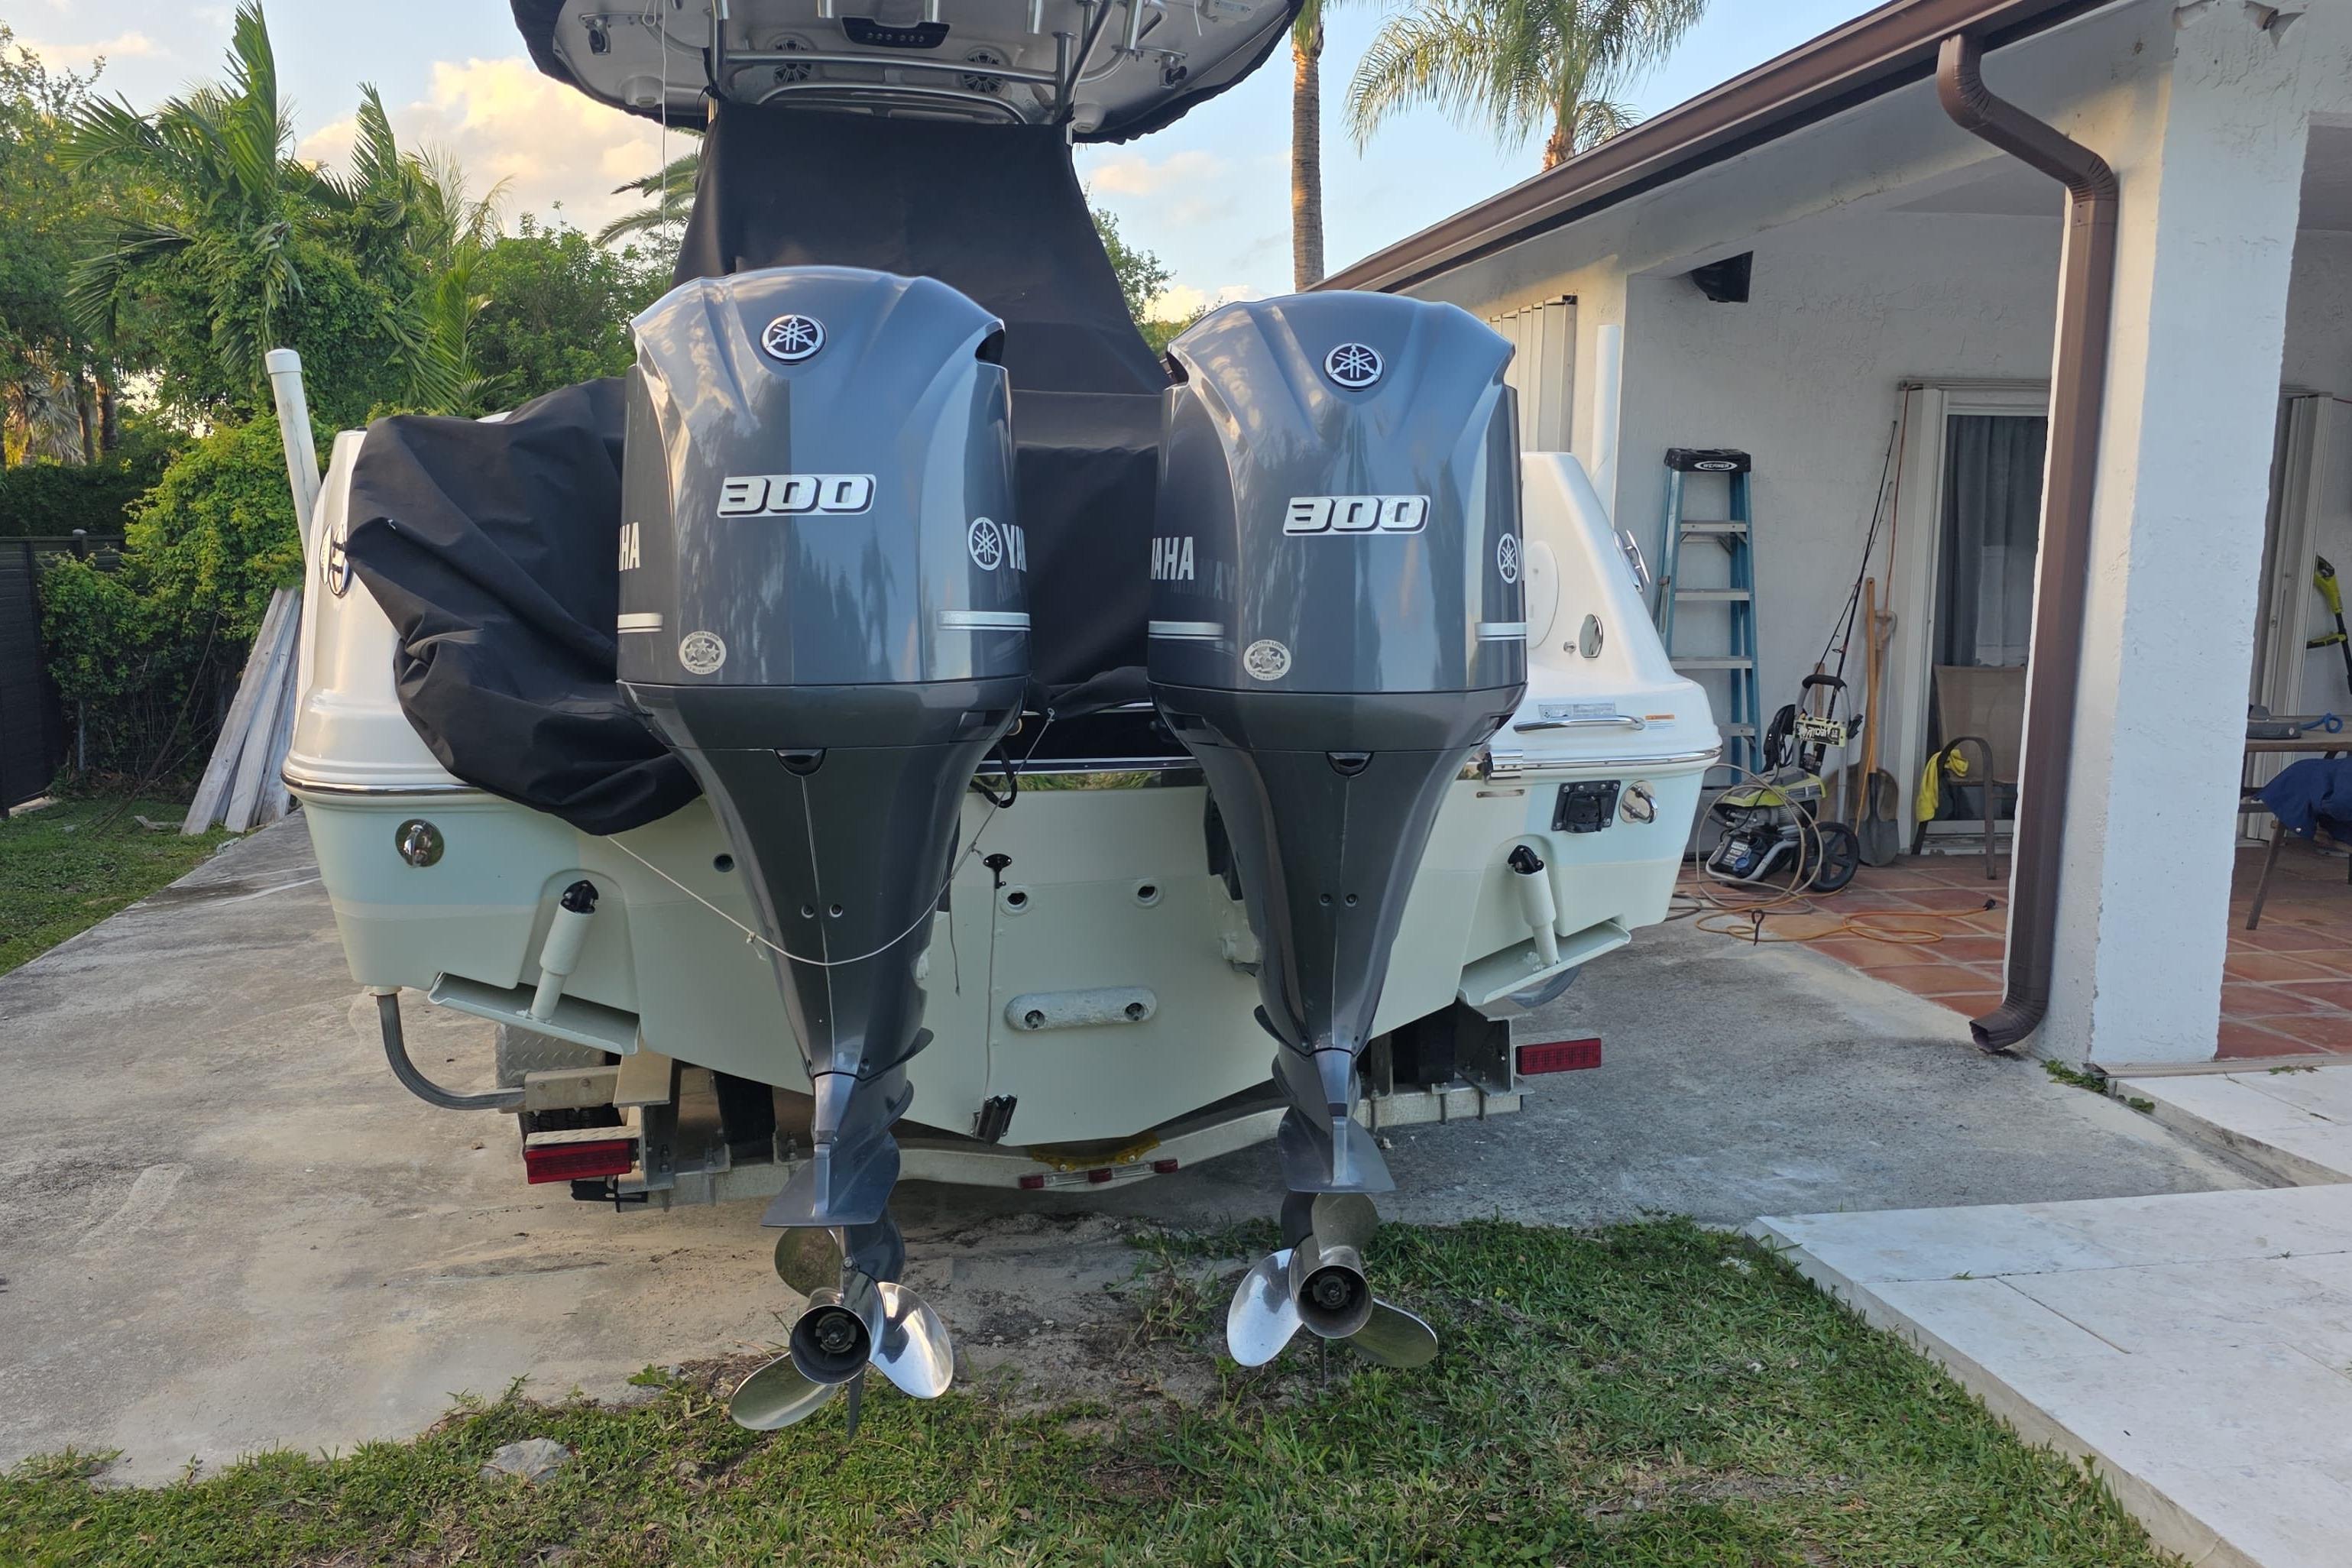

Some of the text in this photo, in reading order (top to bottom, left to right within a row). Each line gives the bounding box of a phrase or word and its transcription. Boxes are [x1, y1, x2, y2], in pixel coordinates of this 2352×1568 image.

[718, 475, 876, 518] 300
[1284, 496, 1430, 536] 300
[619, 522, 640, 572] HA
[1002, 523, 1027, 572] YA
[1151, 536, 1194, 580] AHA
